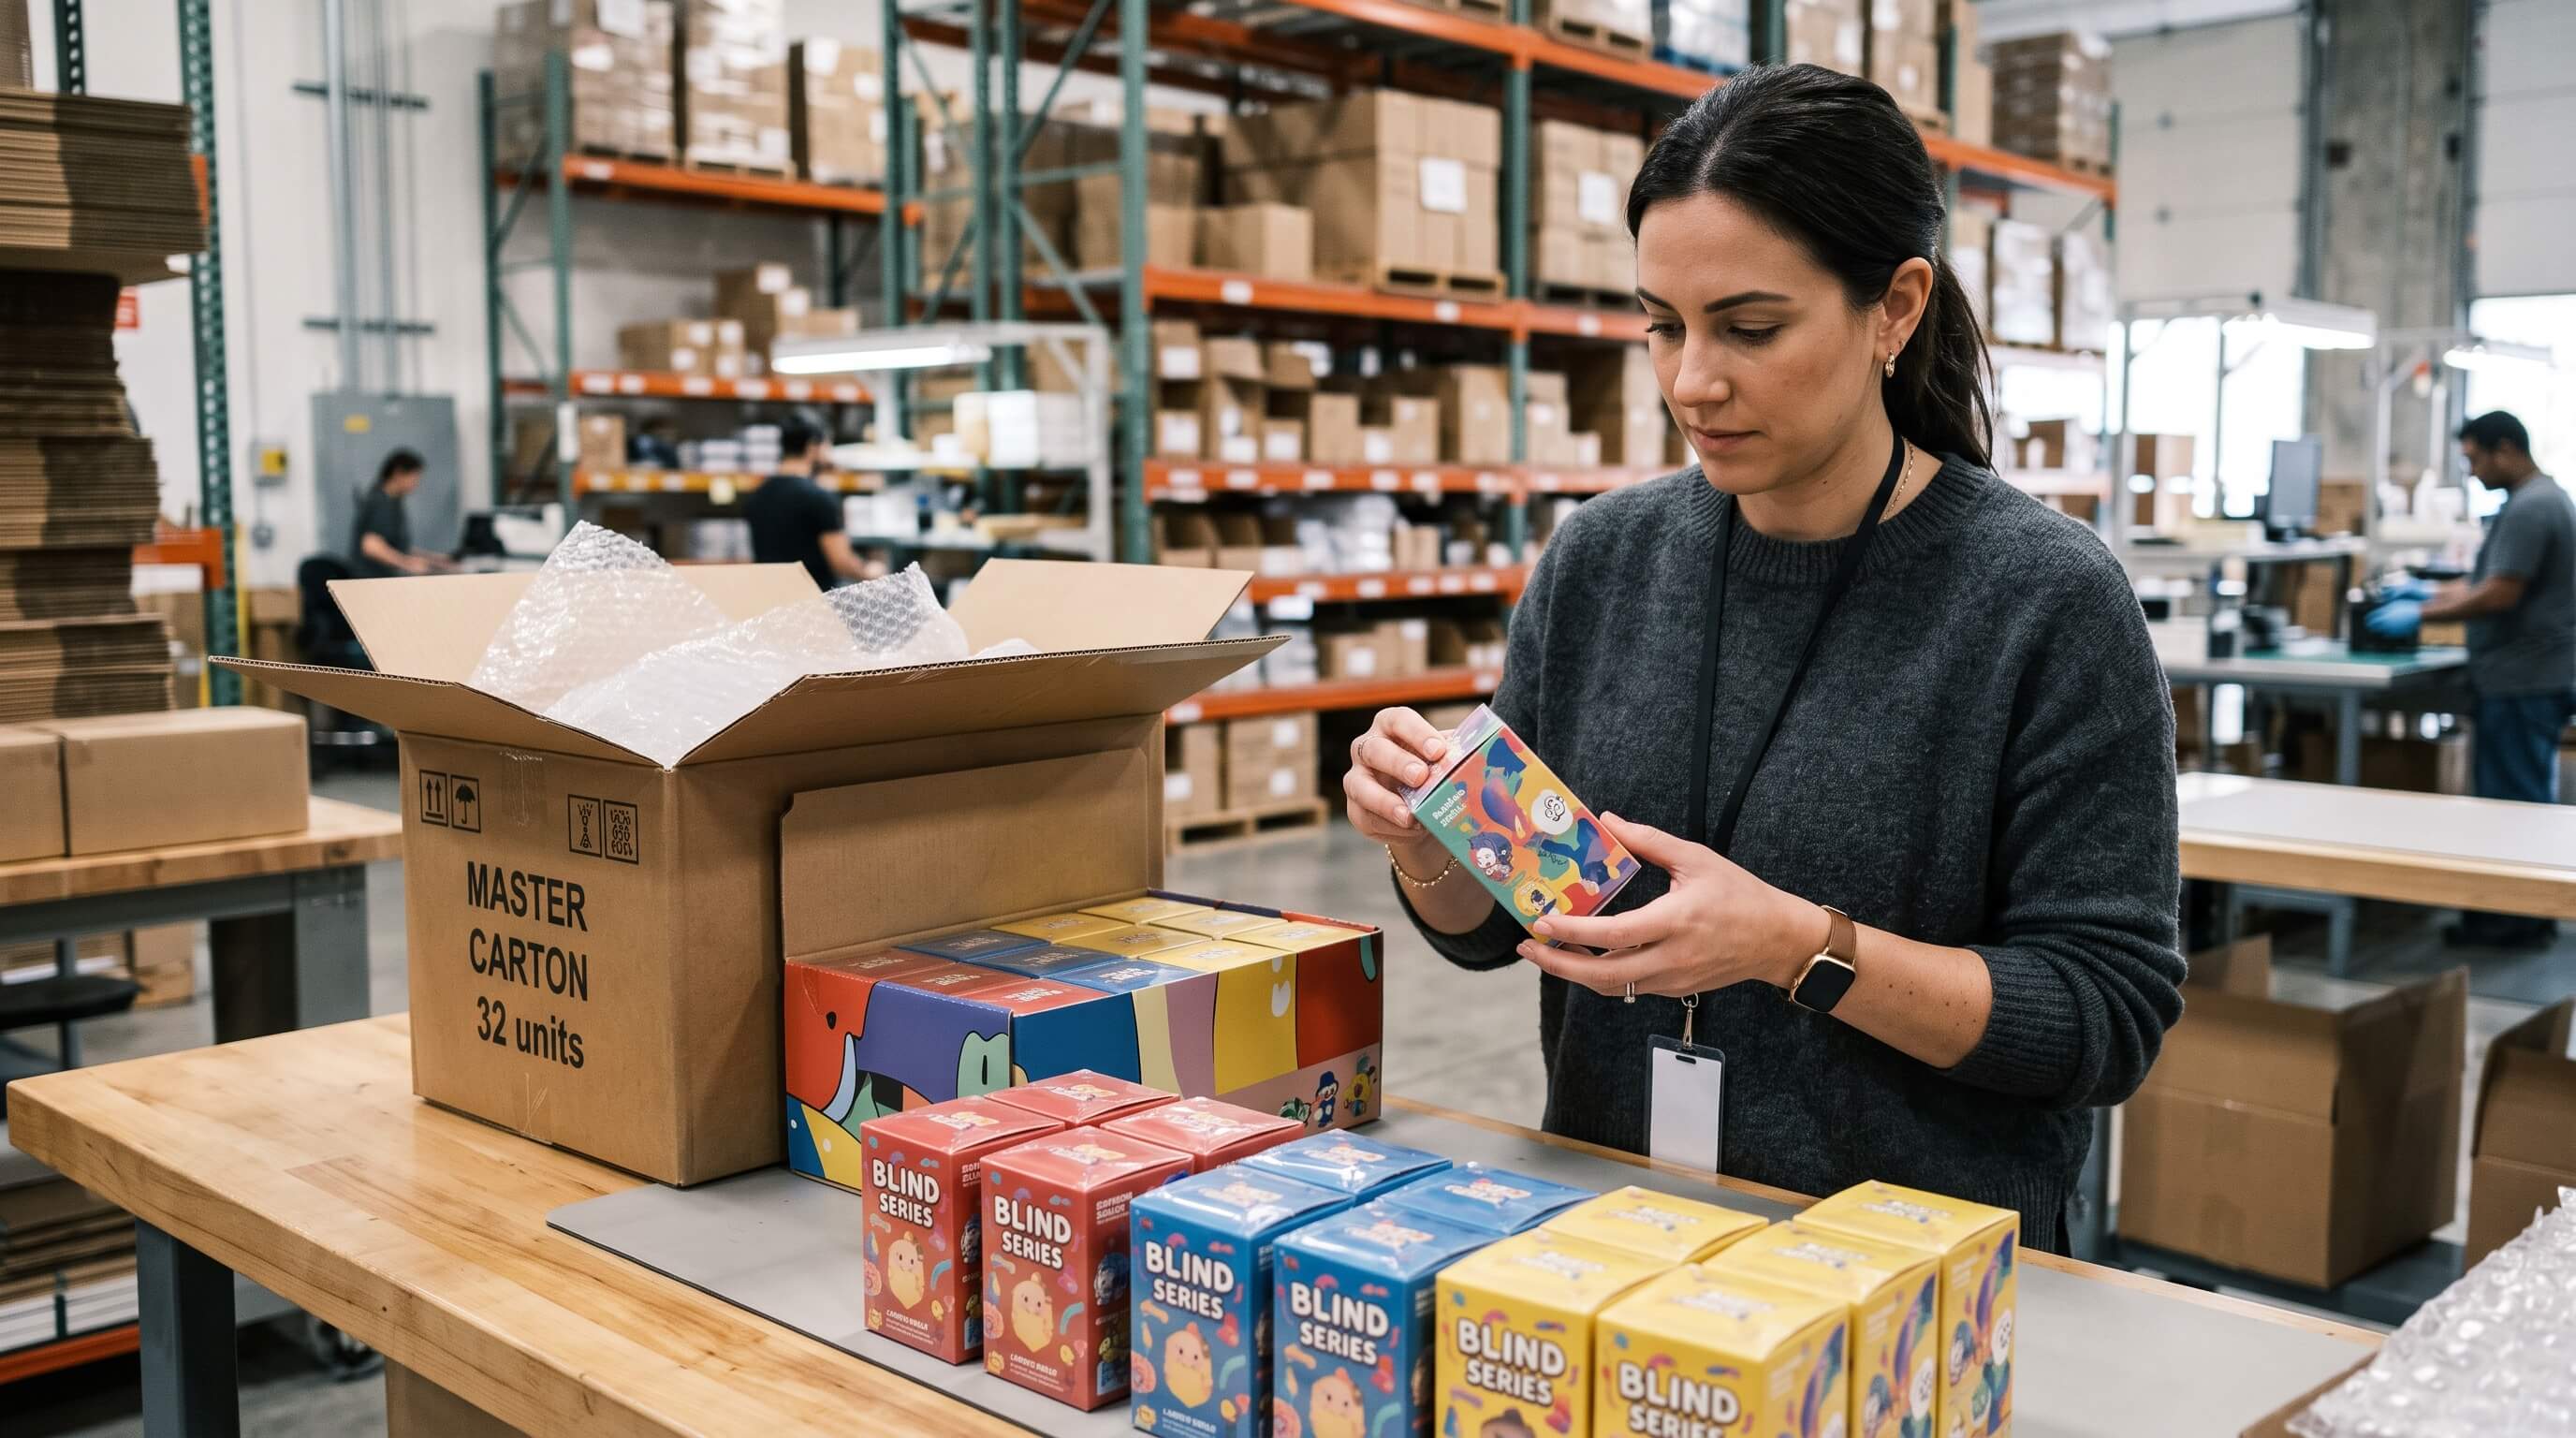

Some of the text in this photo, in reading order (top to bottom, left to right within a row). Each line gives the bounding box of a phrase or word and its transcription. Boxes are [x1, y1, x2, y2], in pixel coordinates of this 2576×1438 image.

[468, 861, 588, 932] MASTER
[470, 928, 588, 1002] CARTON
[477, 996, 584, 1068] 32 units
[872, 1159, 940, 1204] BLIND
[879, 1195, 933, 1227] SERIES
[994, 1196, 1072, 1244] BLIND
[1002, 1231, 1062, 1269] SERIES
[1145, 1240, 1235, 1293] BLIND
[1153, 1279, 1223, 1320] SERIES
[1291, 1282, 1389, 1337] BLIND
[1300, 1321, 1377, 1365] SERIES
[1457, 1318, 1565, 1376] BLIND
[1467, 1357, 1553, 1405] SERIES
[1618, 1361, 1739, 1424] BLIND
